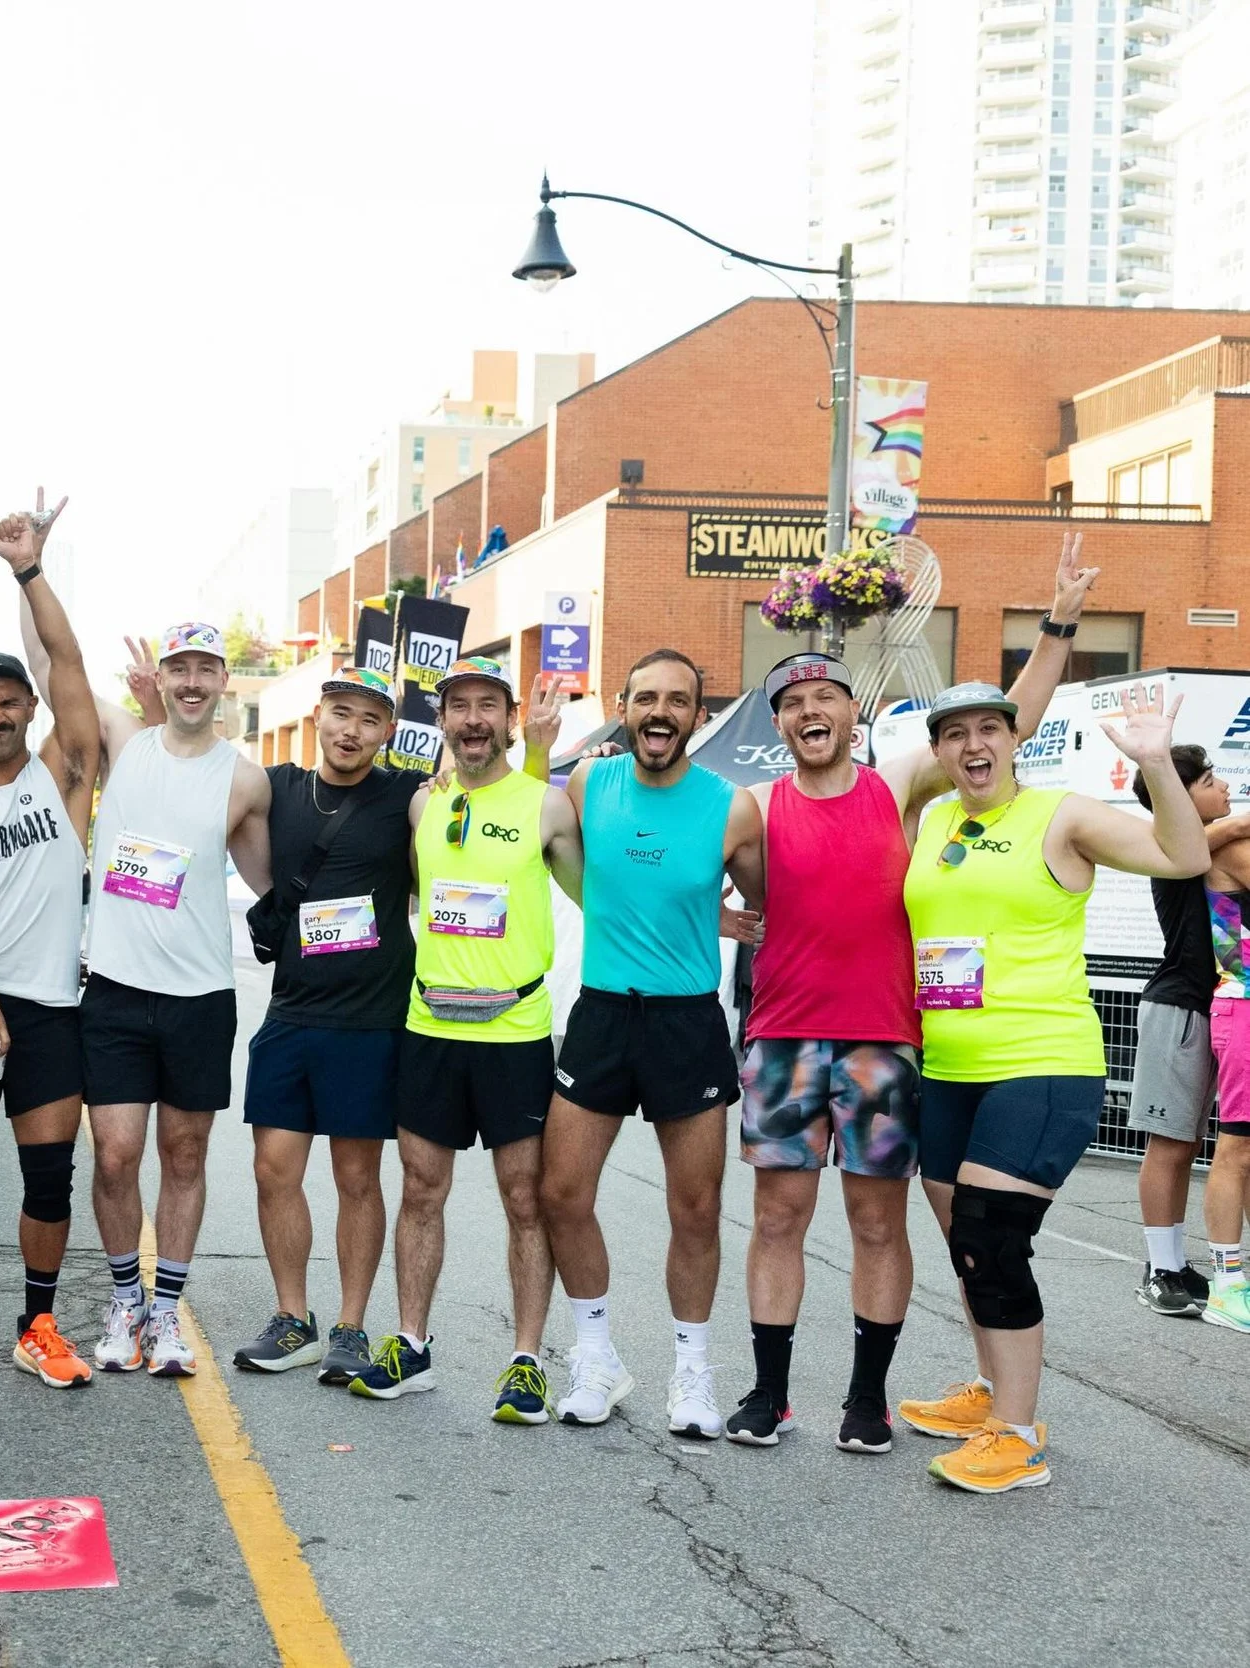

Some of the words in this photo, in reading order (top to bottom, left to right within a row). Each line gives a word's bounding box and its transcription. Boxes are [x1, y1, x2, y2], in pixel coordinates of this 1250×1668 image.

[696, 523, 889, 560] STEAMWOKS
[411, 641, 453, 671] 102.1
[398, 728, 438, 758] 102.1
[118, 844, 137, 856] cory
[114, 859, 148, 878] 3799
[434, 892, 447, 903] a.j.
[304, 915, 321, 925] gary
[434, 910, 467, 926] 2075
[306, 929, 341, 944] 3807
[919, 970, 944, 985] 3575
